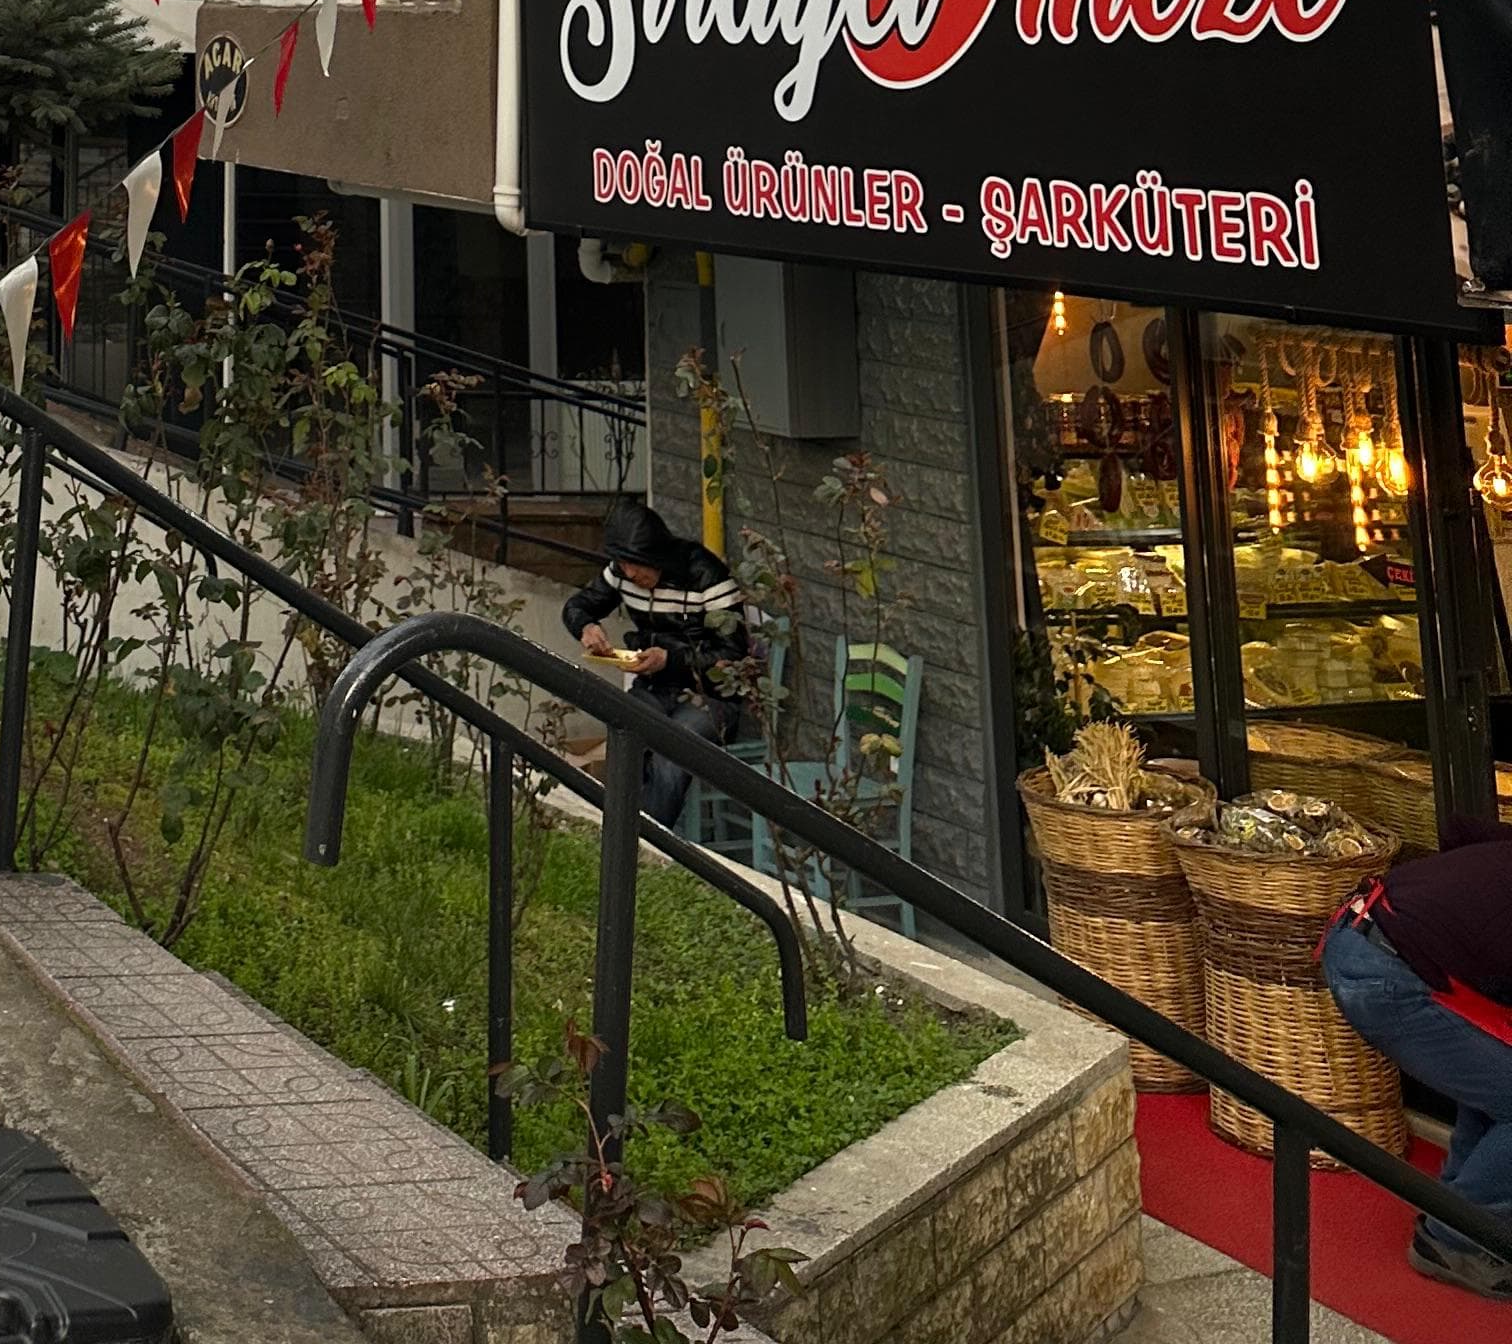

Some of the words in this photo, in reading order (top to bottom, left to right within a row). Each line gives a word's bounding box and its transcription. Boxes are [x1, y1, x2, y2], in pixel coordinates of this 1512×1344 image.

[203, 41, 244, 80] ACAR
[592, 139, 712, 211] DOĞAL
[723, 146, 930, 234] ÜRÜNLER
[981, 170, 1322, 271] ŞARKÜTERİ
